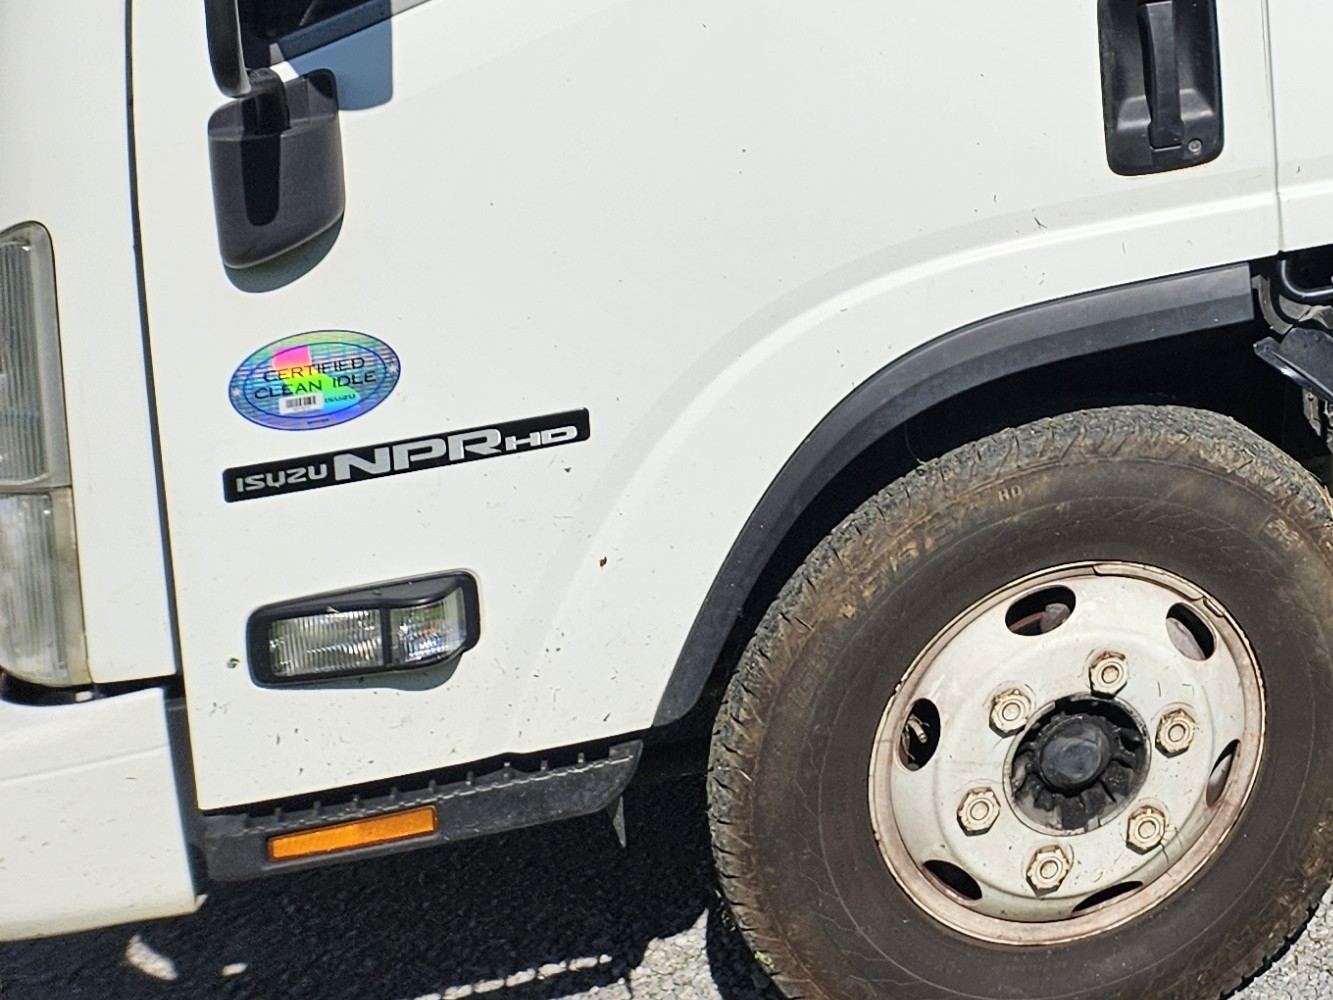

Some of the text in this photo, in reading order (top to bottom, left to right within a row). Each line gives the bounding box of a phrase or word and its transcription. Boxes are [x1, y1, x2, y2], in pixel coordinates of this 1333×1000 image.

[264, 357, 366, 382] CERTIFIED
[254, 370, 376, 399] CLEAN IDLE
[325, 394, 356, 403] ISUZU
[236, 425, 578, 493] ISUZU NPR HD
